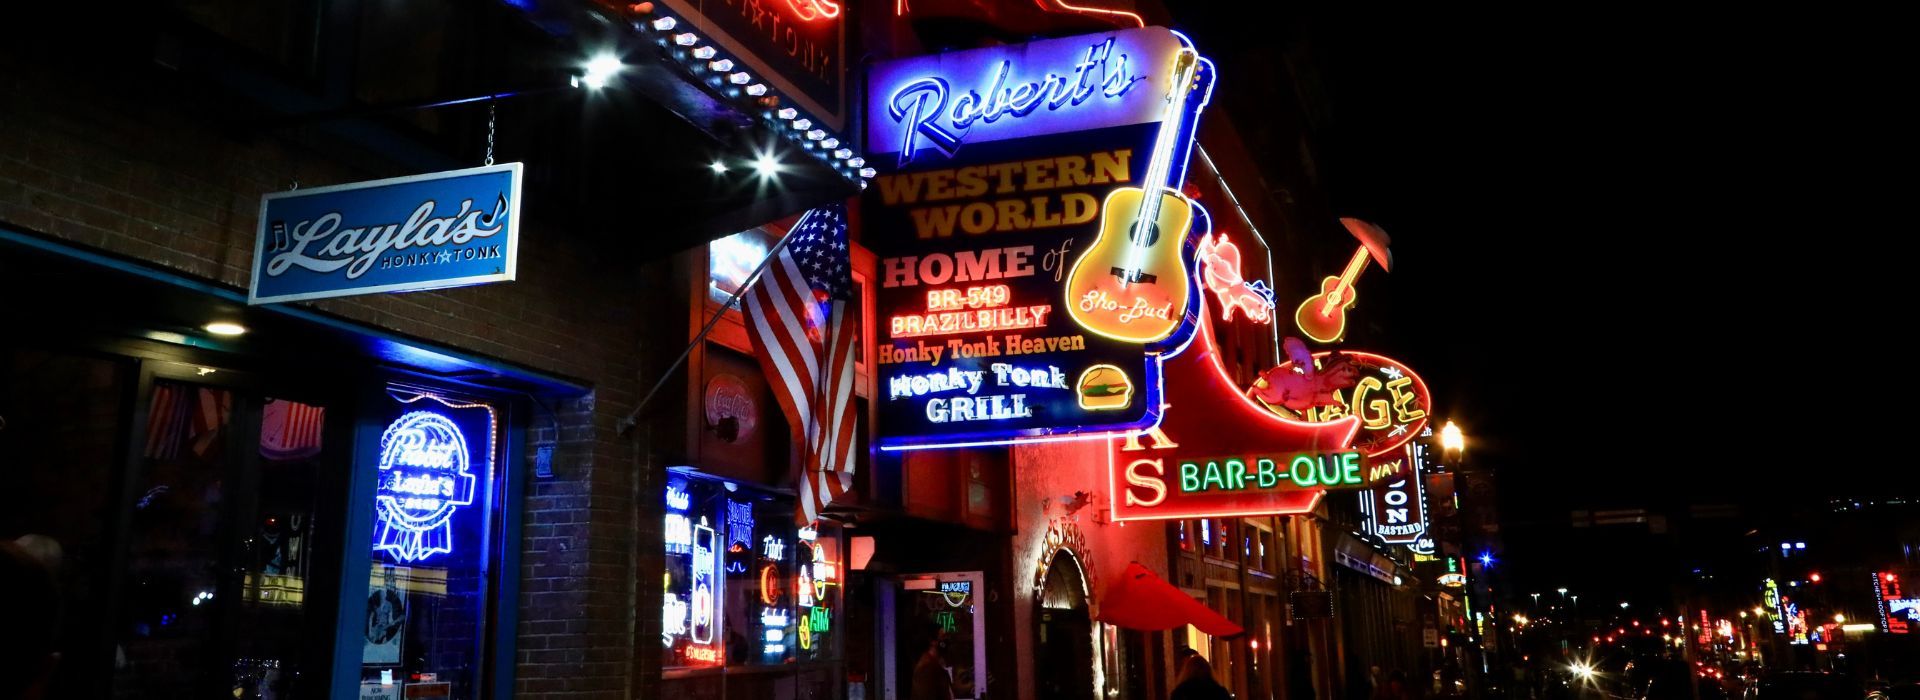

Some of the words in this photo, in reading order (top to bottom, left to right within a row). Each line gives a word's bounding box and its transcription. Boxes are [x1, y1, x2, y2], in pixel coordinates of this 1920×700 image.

[889, 37, 1136, 165] Robert's
[879, 149, 1132, 206] WESTERN
[910, 192, 1099, 239] WORLD
[267, 199, 503, 279] Layla's
[883, 245, 1035, 288] HOME
[1043, 238, 1074, 282] of
[927, 285, 1011, 312] BR-549
[1080, 289, 1173, 323] Sho-Bud
[890, 304, 1051, 338] BRAZILBILLY
[878, 340, 948, 366] Honky
[949, 335, 1001, 359] Tonk
[1005, 333, 1085, 356] Heaven
[890, 366, 984, 400] Honky
[991, 362, 1069, 391] Tonk
[926, 393, 1032, 423] GRILL
[1180, 452, 1363, 493] BAR-B-QUE
[1378, 522, 1421, 536] BASTARD
[810, 606, 829, 632] ATM
